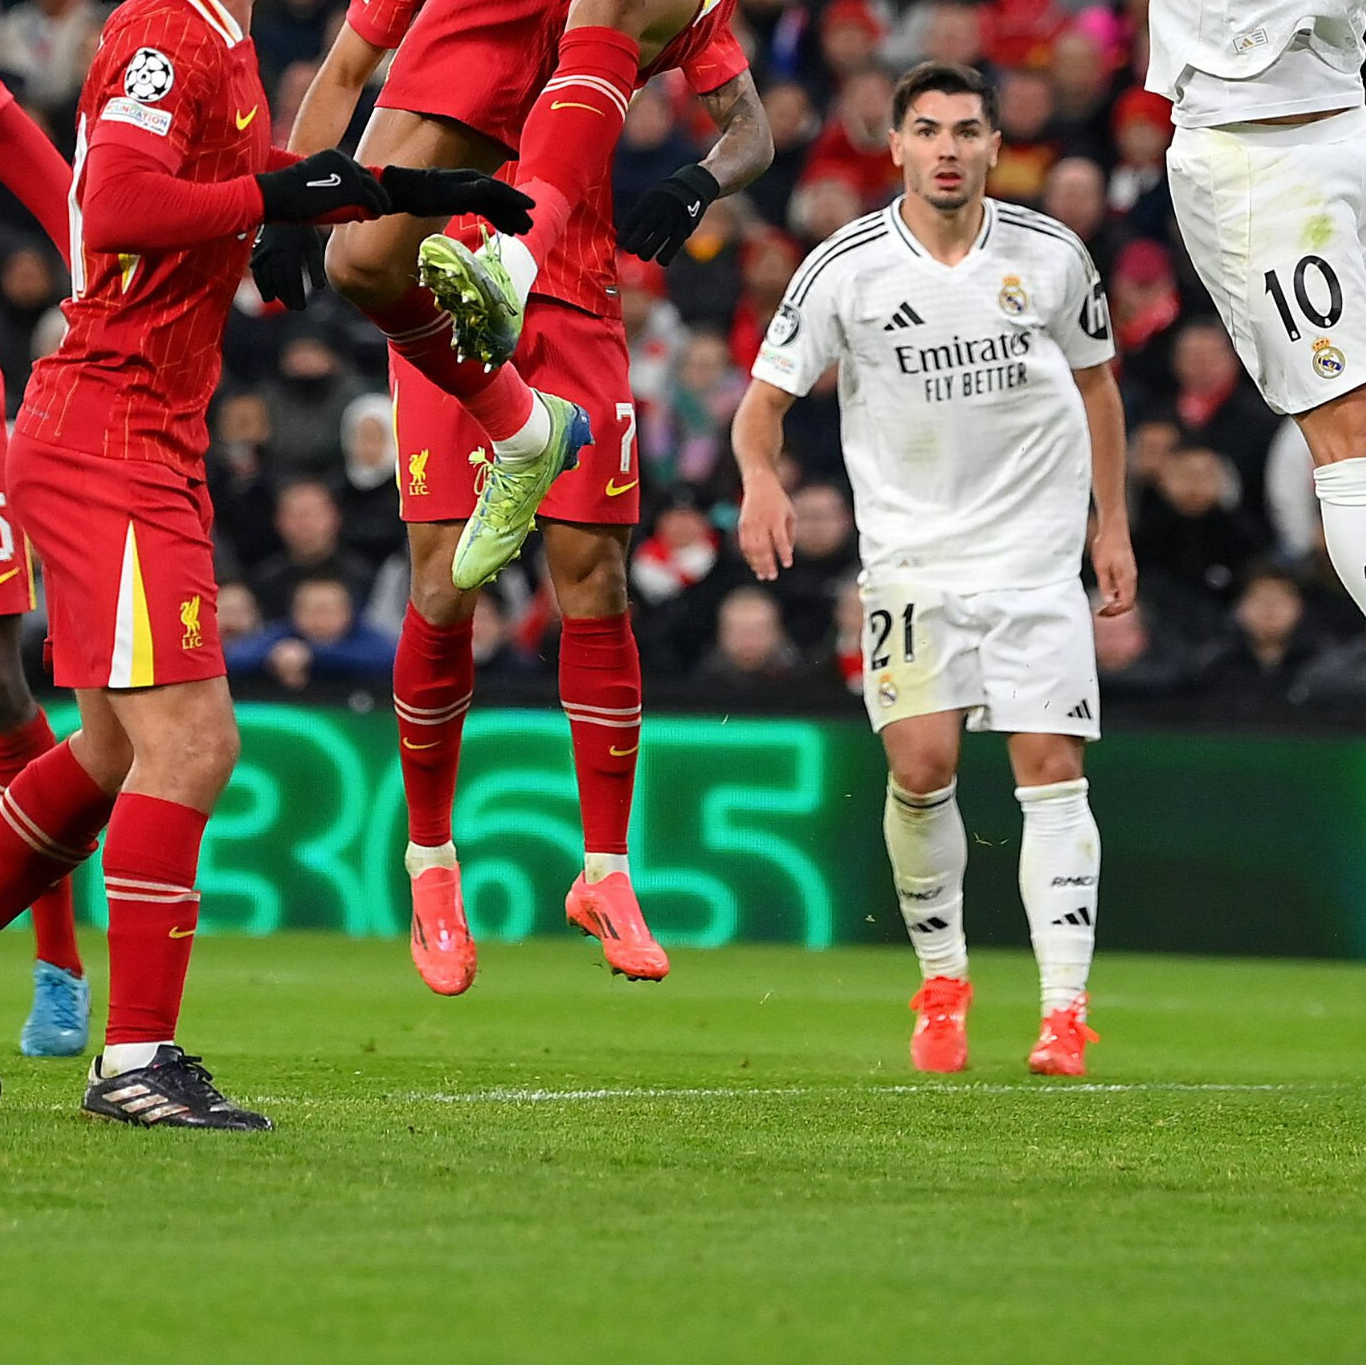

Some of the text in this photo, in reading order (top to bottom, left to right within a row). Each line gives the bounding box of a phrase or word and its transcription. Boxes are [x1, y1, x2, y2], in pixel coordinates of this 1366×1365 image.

[1263, 255, 1344, 343] 10
[895, 331, 1032, 375] Emirates
[925, 362, 1028, 403] FLY BETTER
[615, 402, 636, 473] 7
[871, 603, 915, 671] 21
